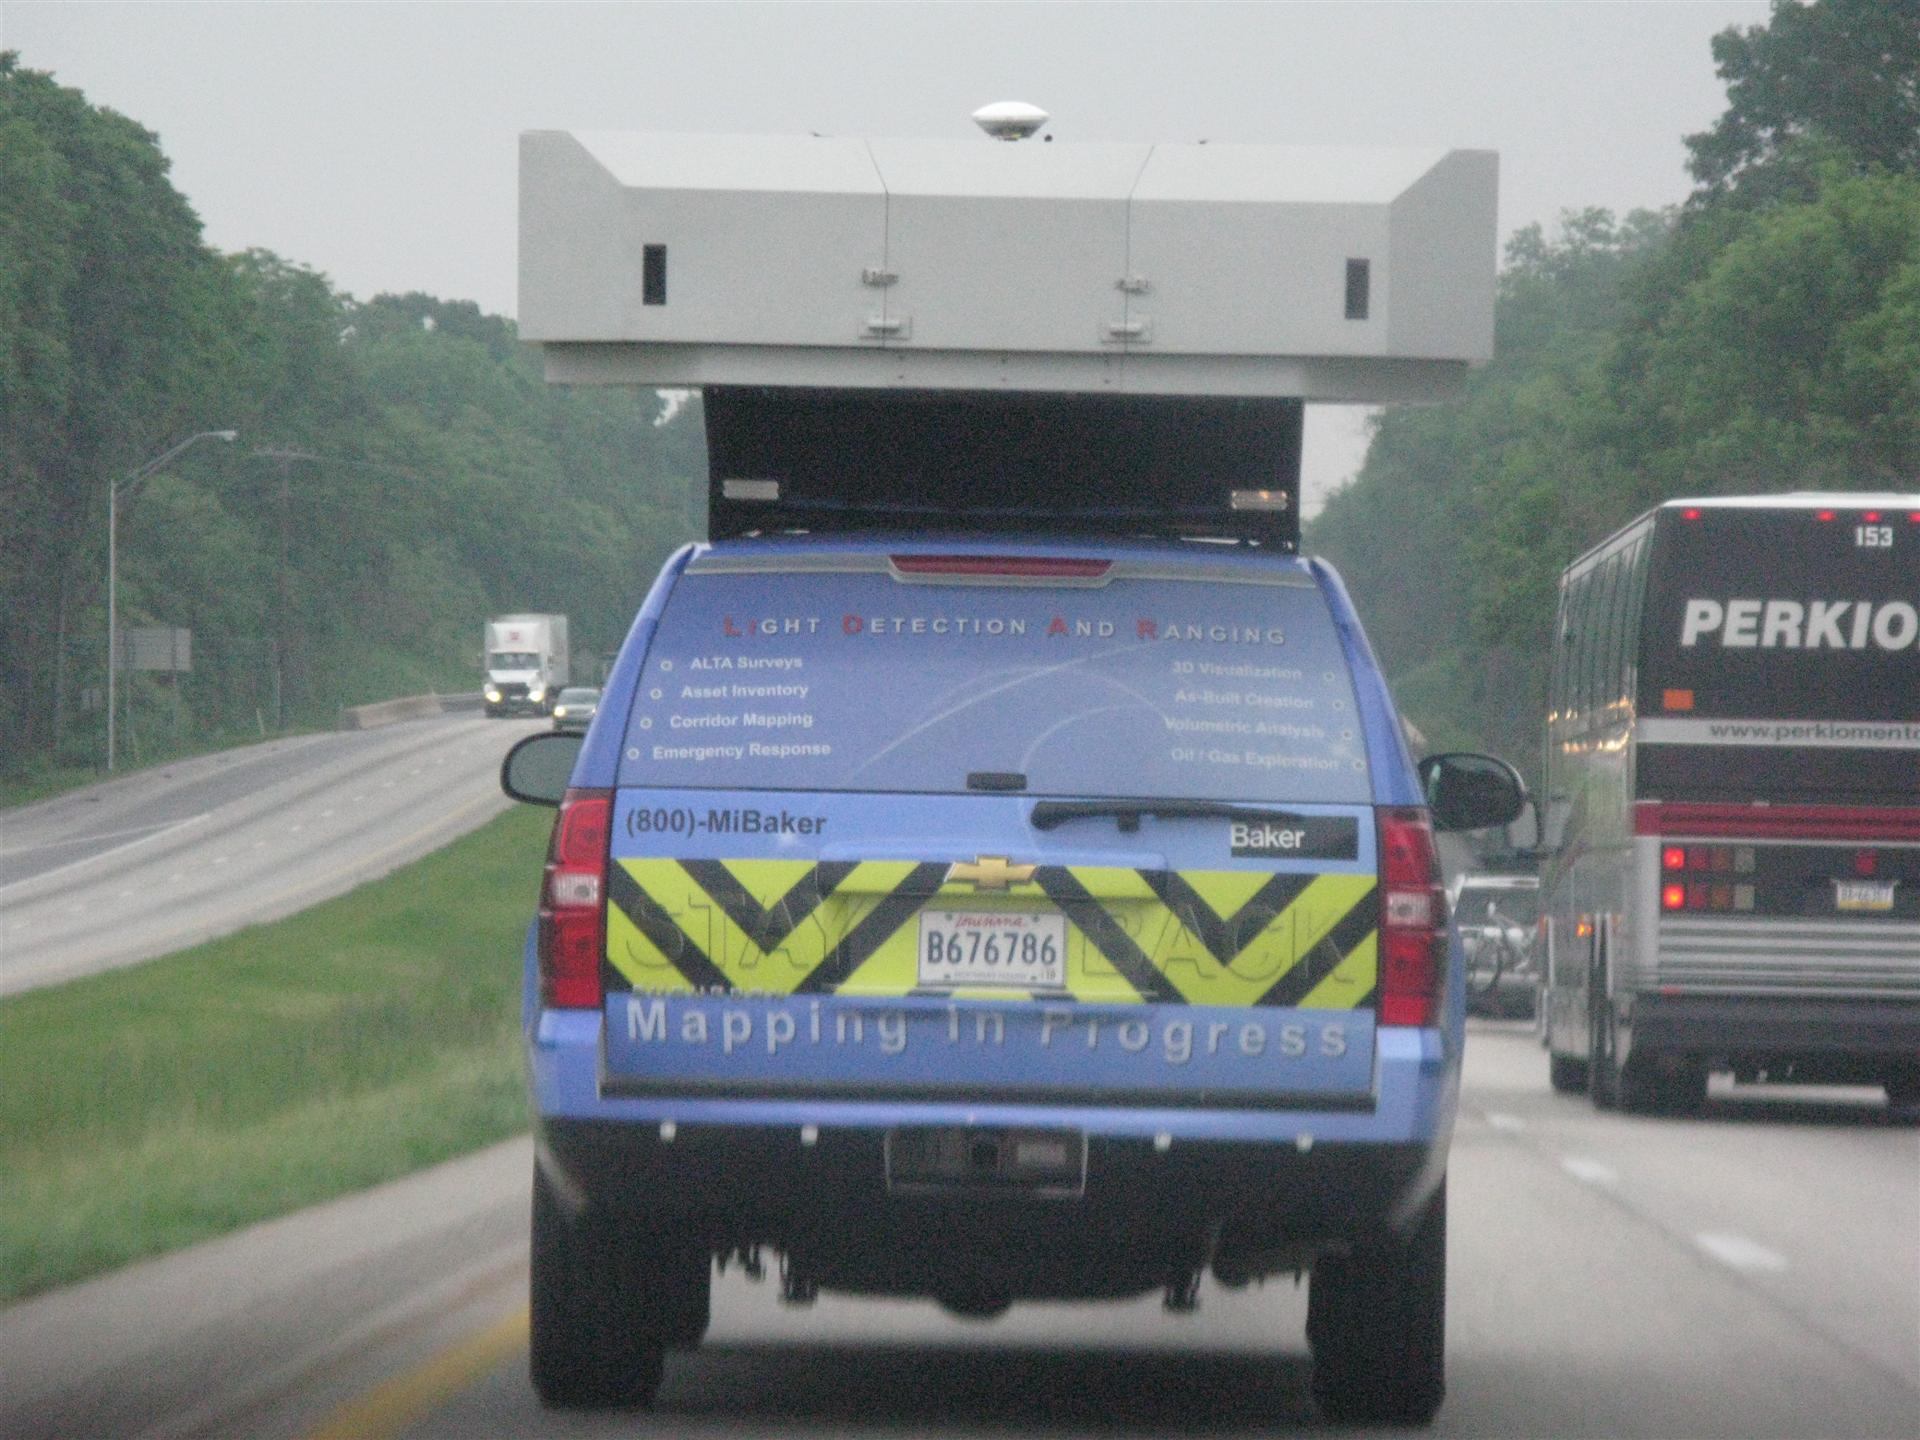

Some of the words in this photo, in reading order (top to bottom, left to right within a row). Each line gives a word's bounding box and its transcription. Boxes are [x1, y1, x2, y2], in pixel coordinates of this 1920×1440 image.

[1856, 526, 1893, 547] 153
[842, 614, 1026, 636] DETECTION
[1046, 617, 1115, 638] AND
[1136, 619, 1286, 646] RANGING
[1681, 600, 1920, 650] PERKIO
[690, 657, 732, 670] ALTA
[737, 656, 804, 670] Surveys
[1172, 661, 1194, 674] 3D
[1199, 663, 1302, 680] Visualization
[681, 685, 727, 698] Asset
[732, 684, 808, 699] Inventory
[670, 715, 738, 728] Corridor
[743, 713, 813, 729] Mapping
[653, 745, 746, 761] Emergency
[749, 743, 831, 757] Response
[626, 807, 827, 838] (800)-MiBaker
[1231, 824, 1305, 849] Baker
[927, 930, 1057, 965] B676786
[627, 998, 908, 1055] Mapping
[1040, 1007, 1347, 1065] Progress
